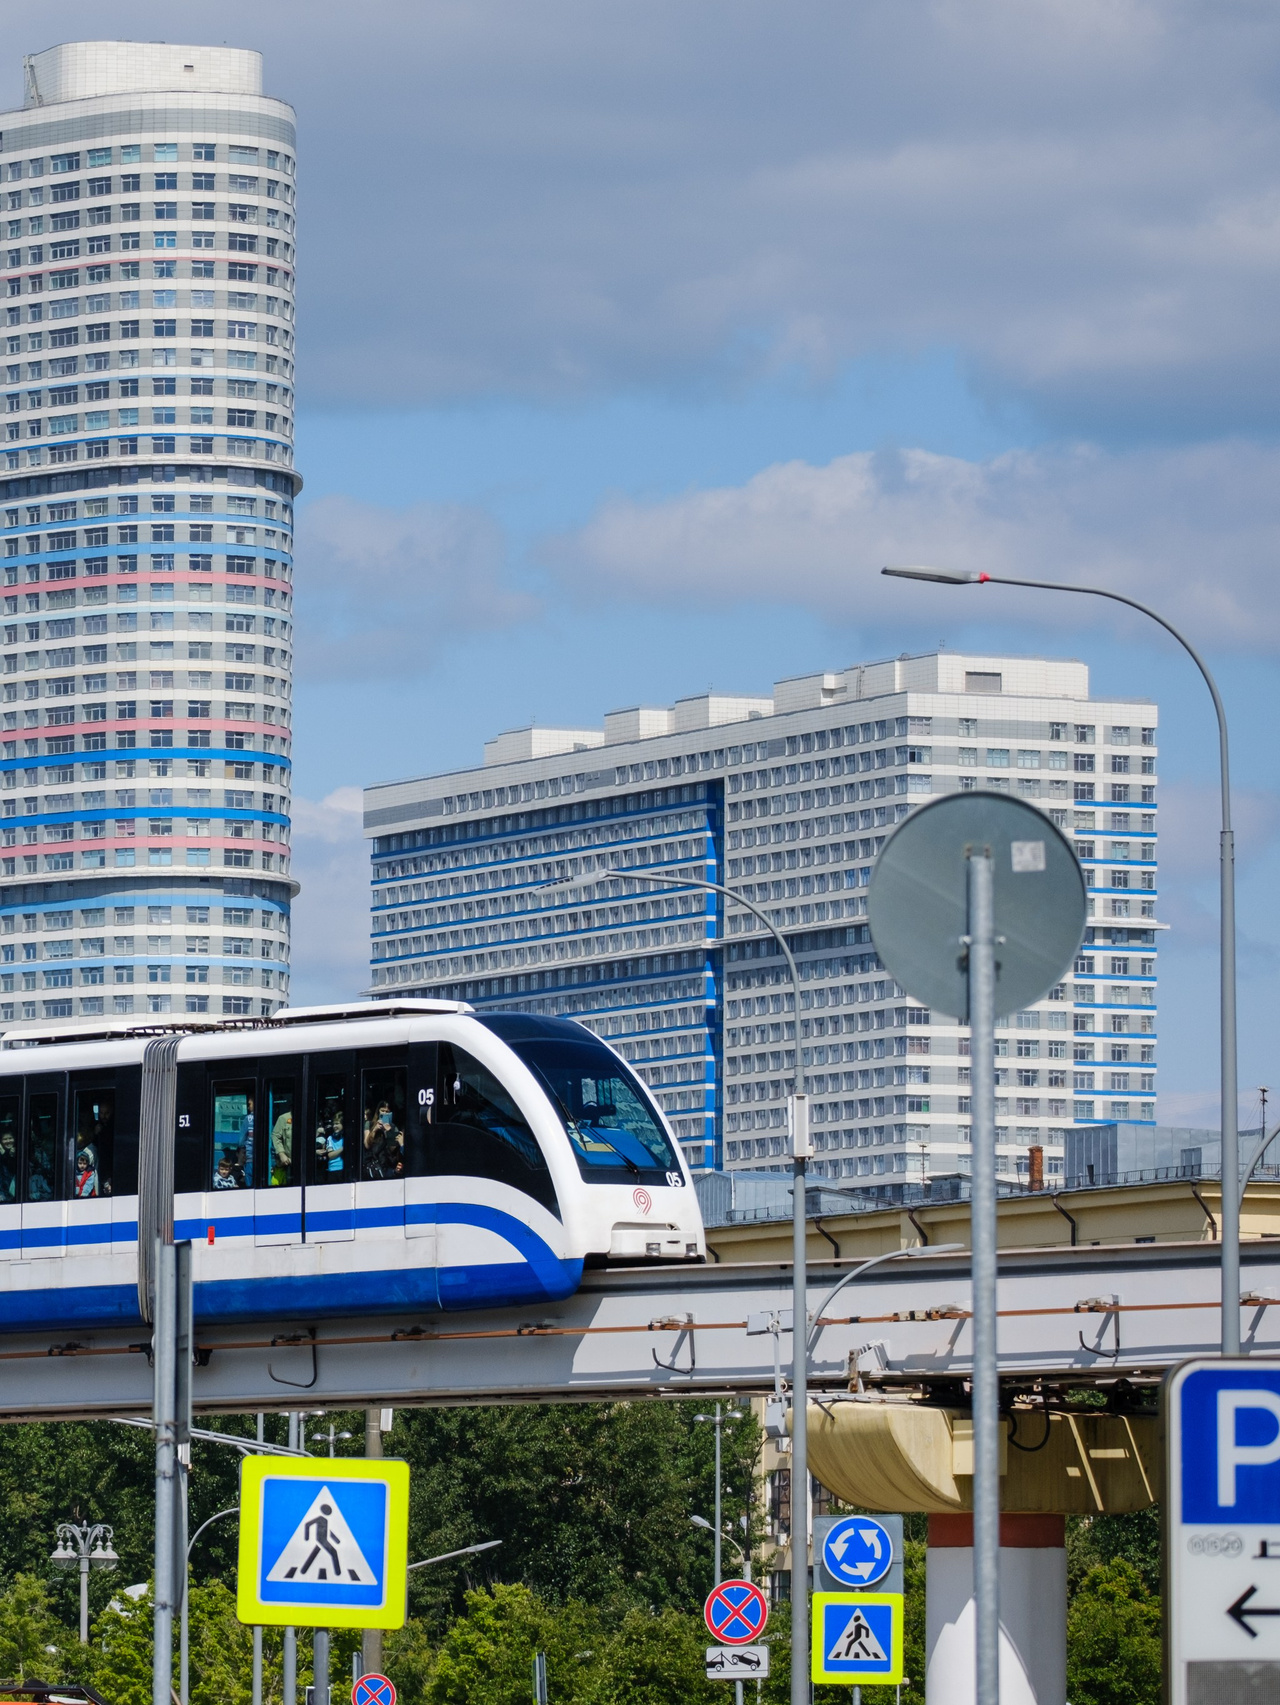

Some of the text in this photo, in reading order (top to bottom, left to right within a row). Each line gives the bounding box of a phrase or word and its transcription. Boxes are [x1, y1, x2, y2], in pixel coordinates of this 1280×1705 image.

[418, 1088, 434, 1105] 05
[178, 1114, 190, 1127] 51
[665, 1171, 682, 1187] 05
[1217, 1389, 1280, 1507] P
